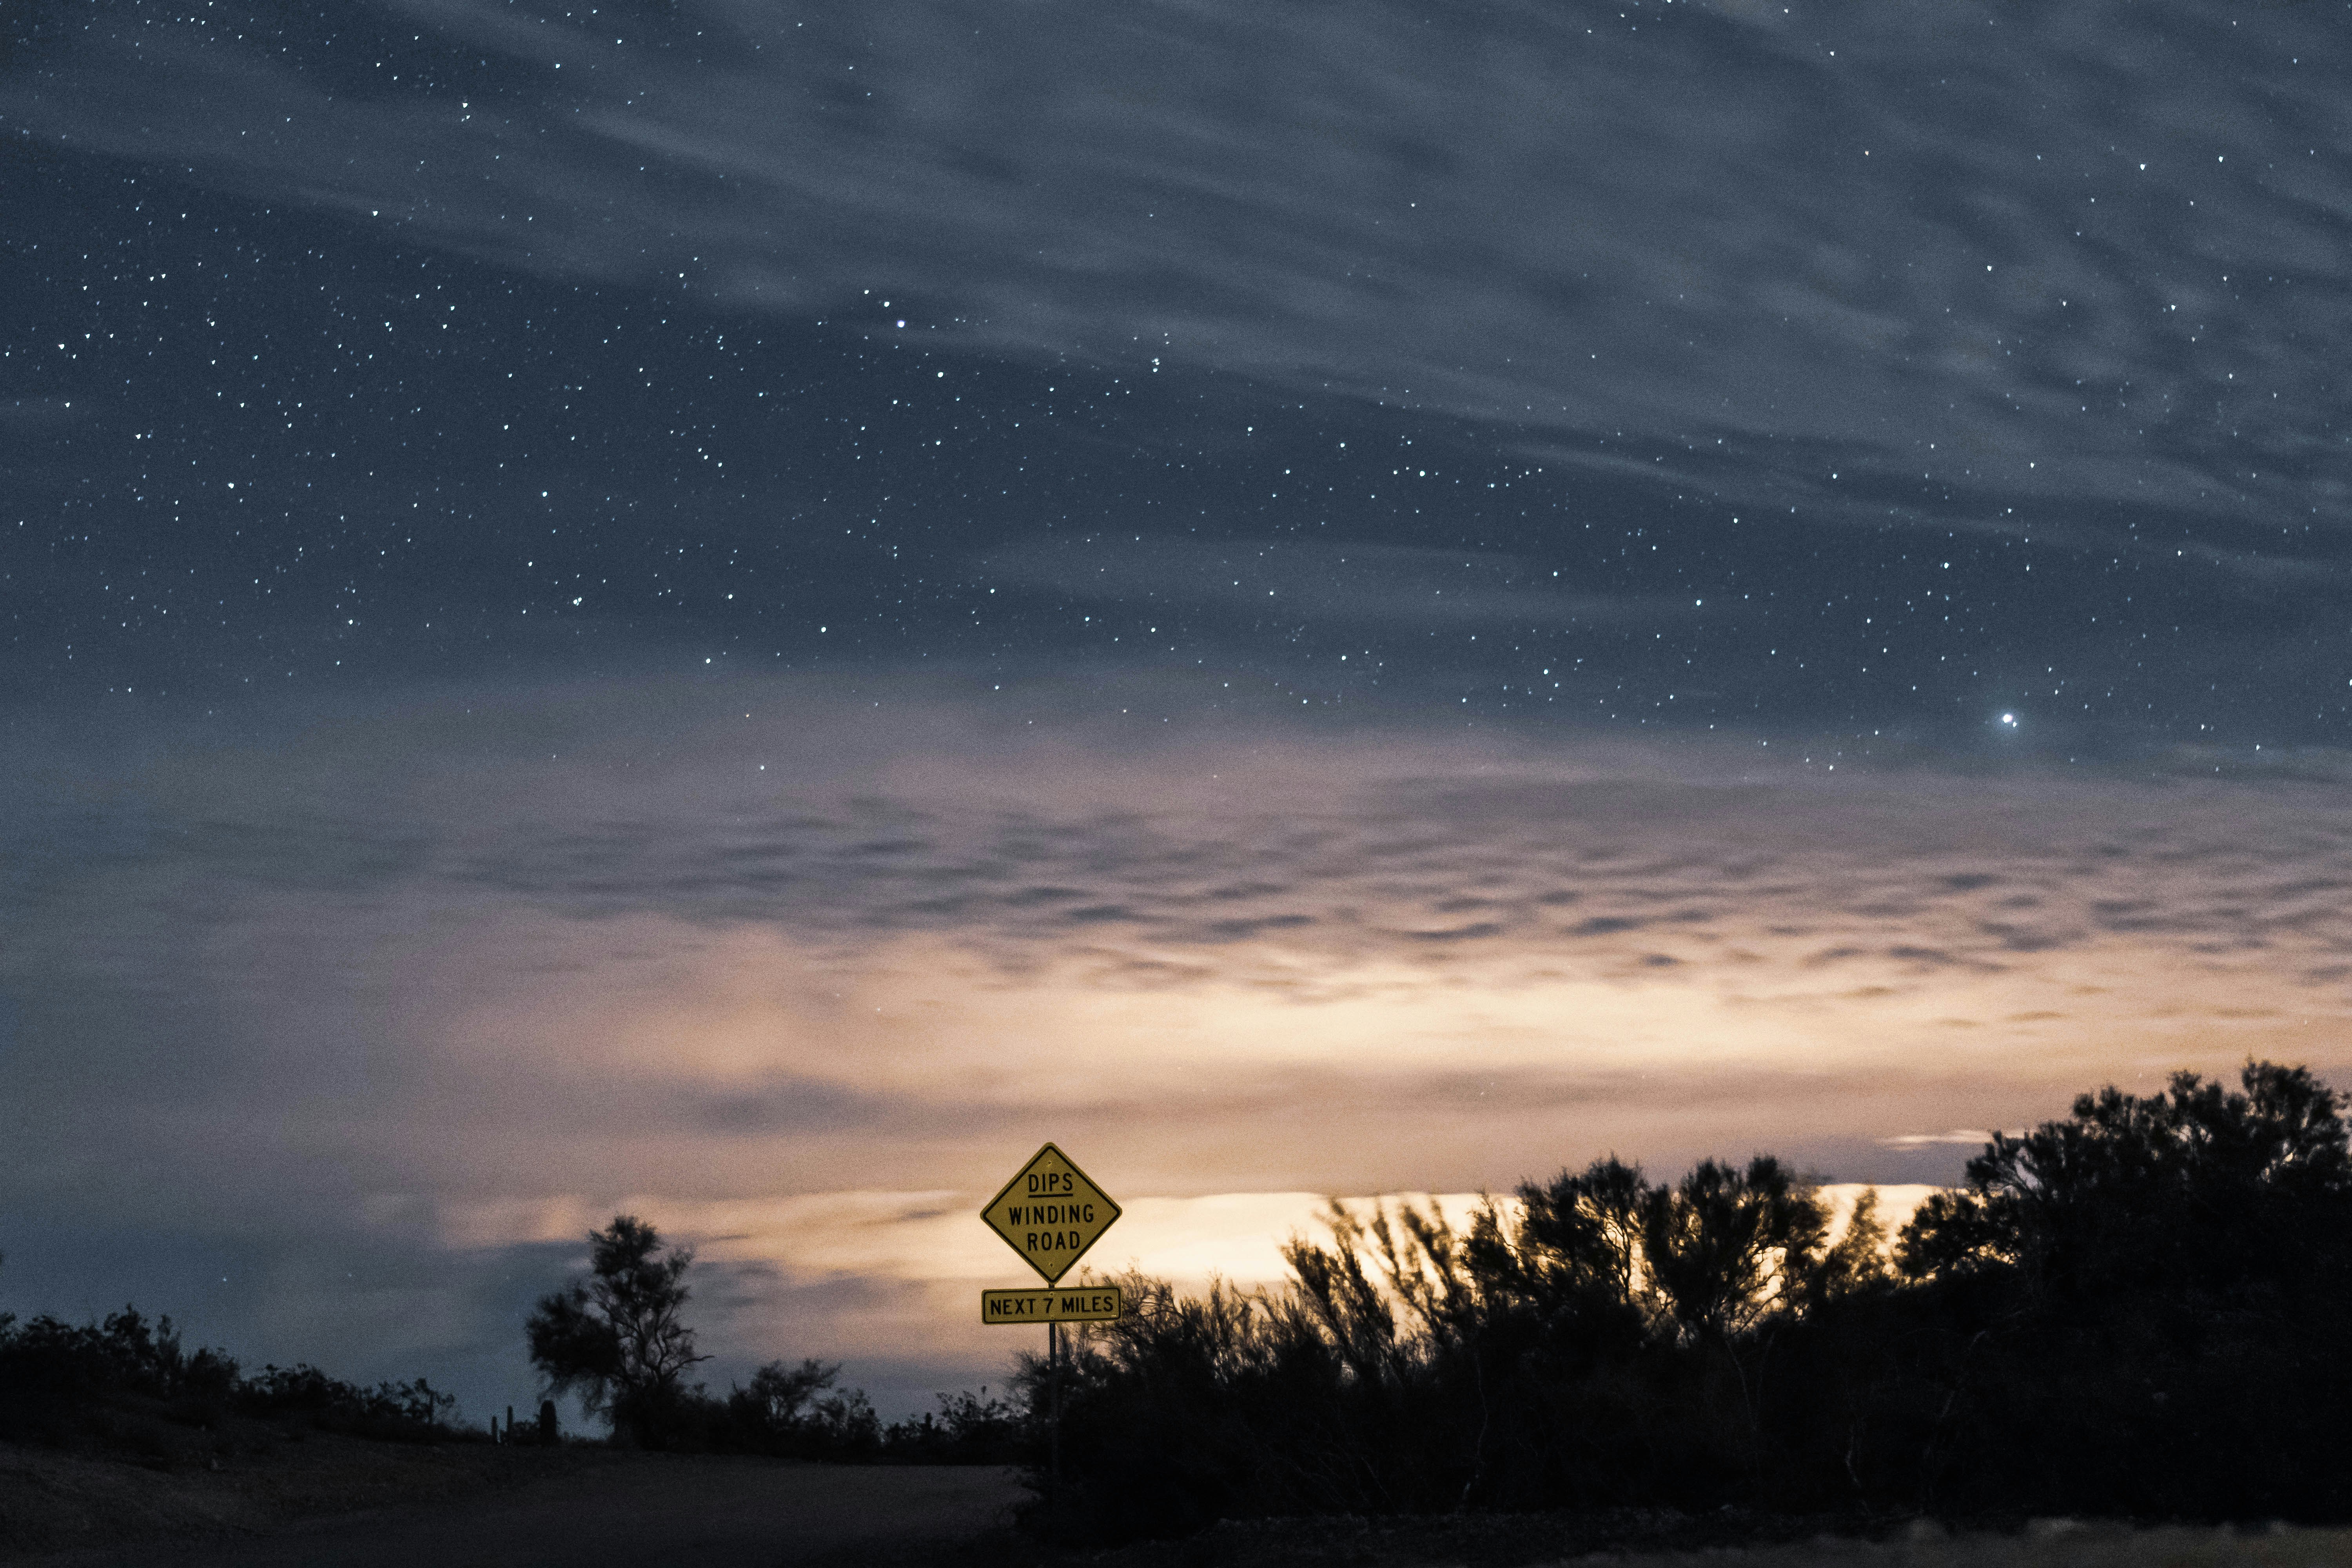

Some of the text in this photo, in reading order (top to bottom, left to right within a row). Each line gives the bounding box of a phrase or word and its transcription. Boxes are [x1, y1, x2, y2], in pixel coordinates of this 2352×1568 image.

[1029, 1173, 1073, 1192] DIPS
[1009, 1204, 1094, 1225] WINDING
[1028, 1231, 1080, 1251] ROAD
[991, 1296, 1114, 1315] NEXT 7 MILES
